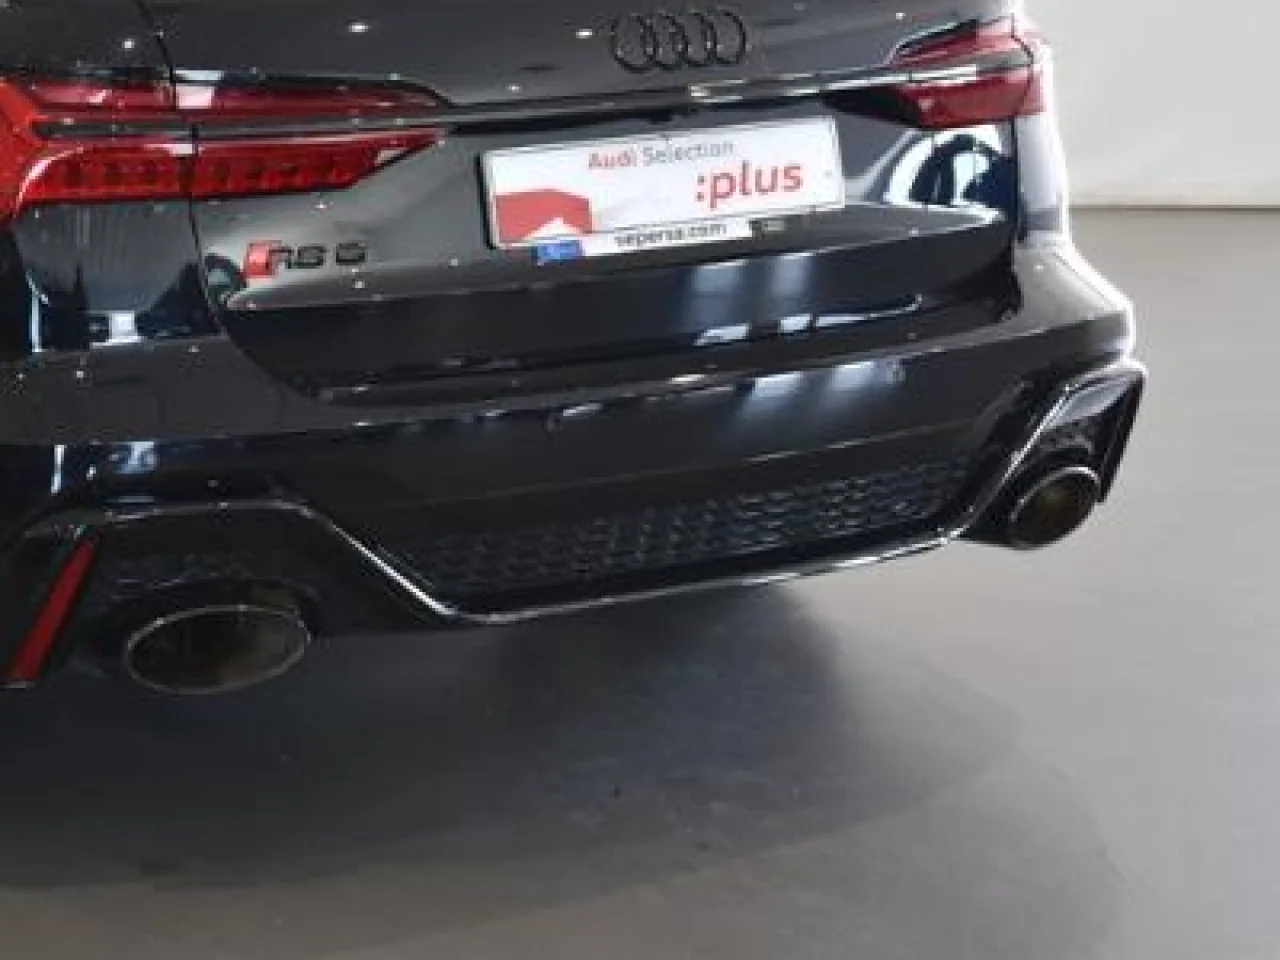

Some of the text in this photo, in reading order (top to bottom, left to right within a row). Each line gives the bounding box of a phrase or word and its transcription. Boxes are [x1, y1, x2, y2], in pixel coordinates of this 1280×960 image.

[587, 140, 735, 170] Audi Selection
[696, 160, 803, 208] :plus
